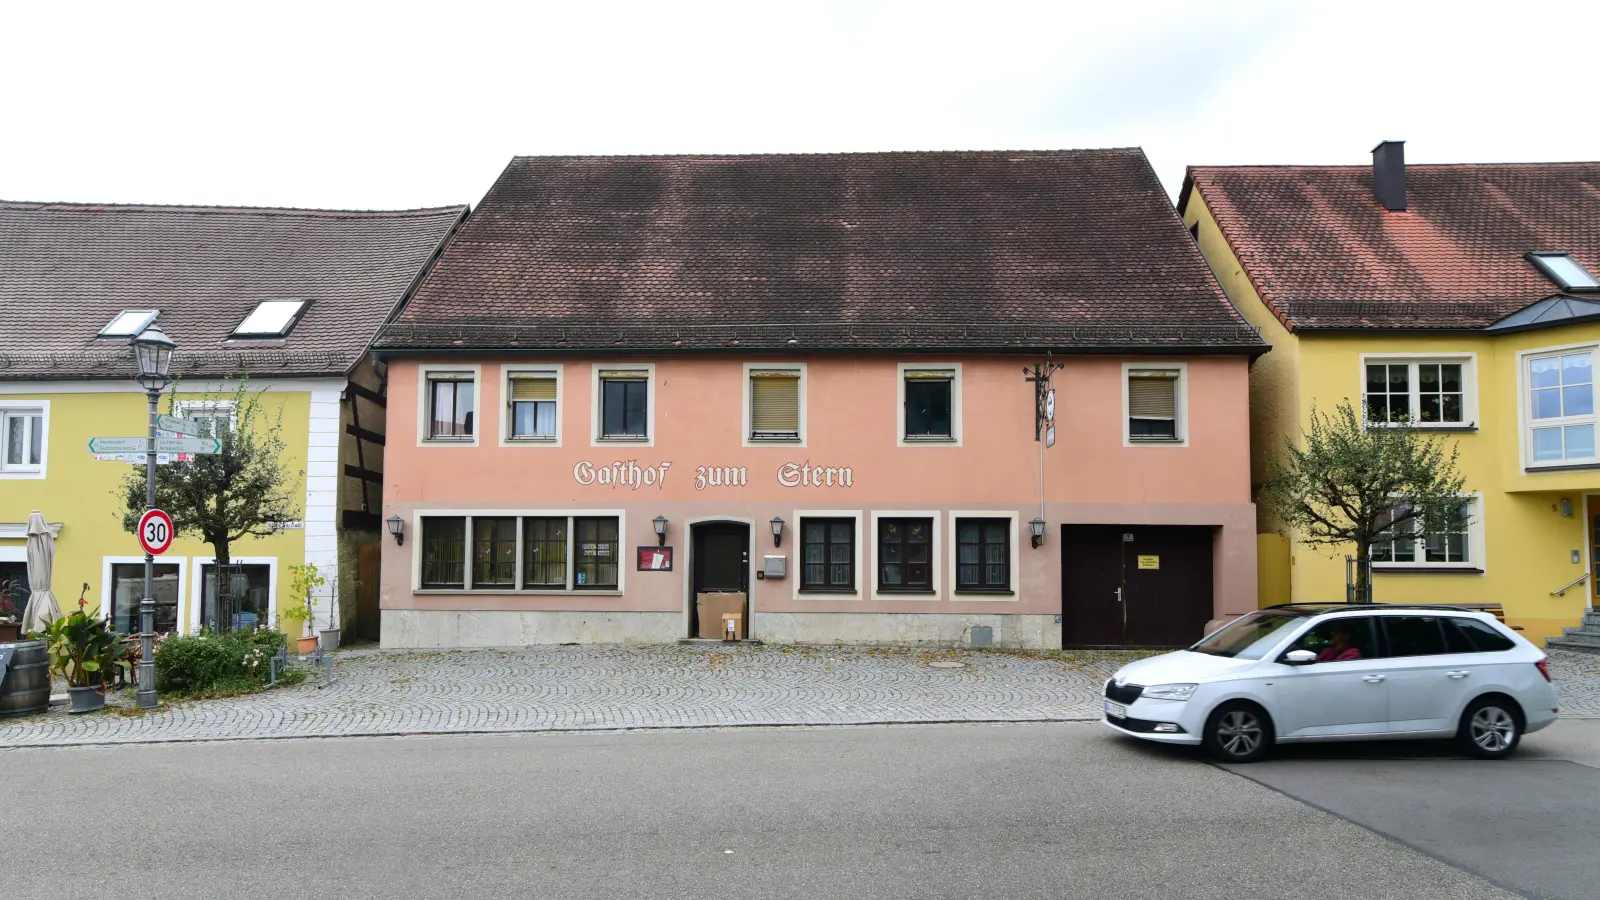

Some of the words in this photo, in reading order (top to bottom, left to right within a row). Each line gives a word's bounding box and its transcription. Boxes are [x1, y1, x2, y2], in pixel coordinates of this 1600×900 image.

[695, 464, 748, 491] zum
[777, 459, 854, 488] Stern
[1551, 504, 1558, 512] 5
[147, 522, 166, 543] 30
